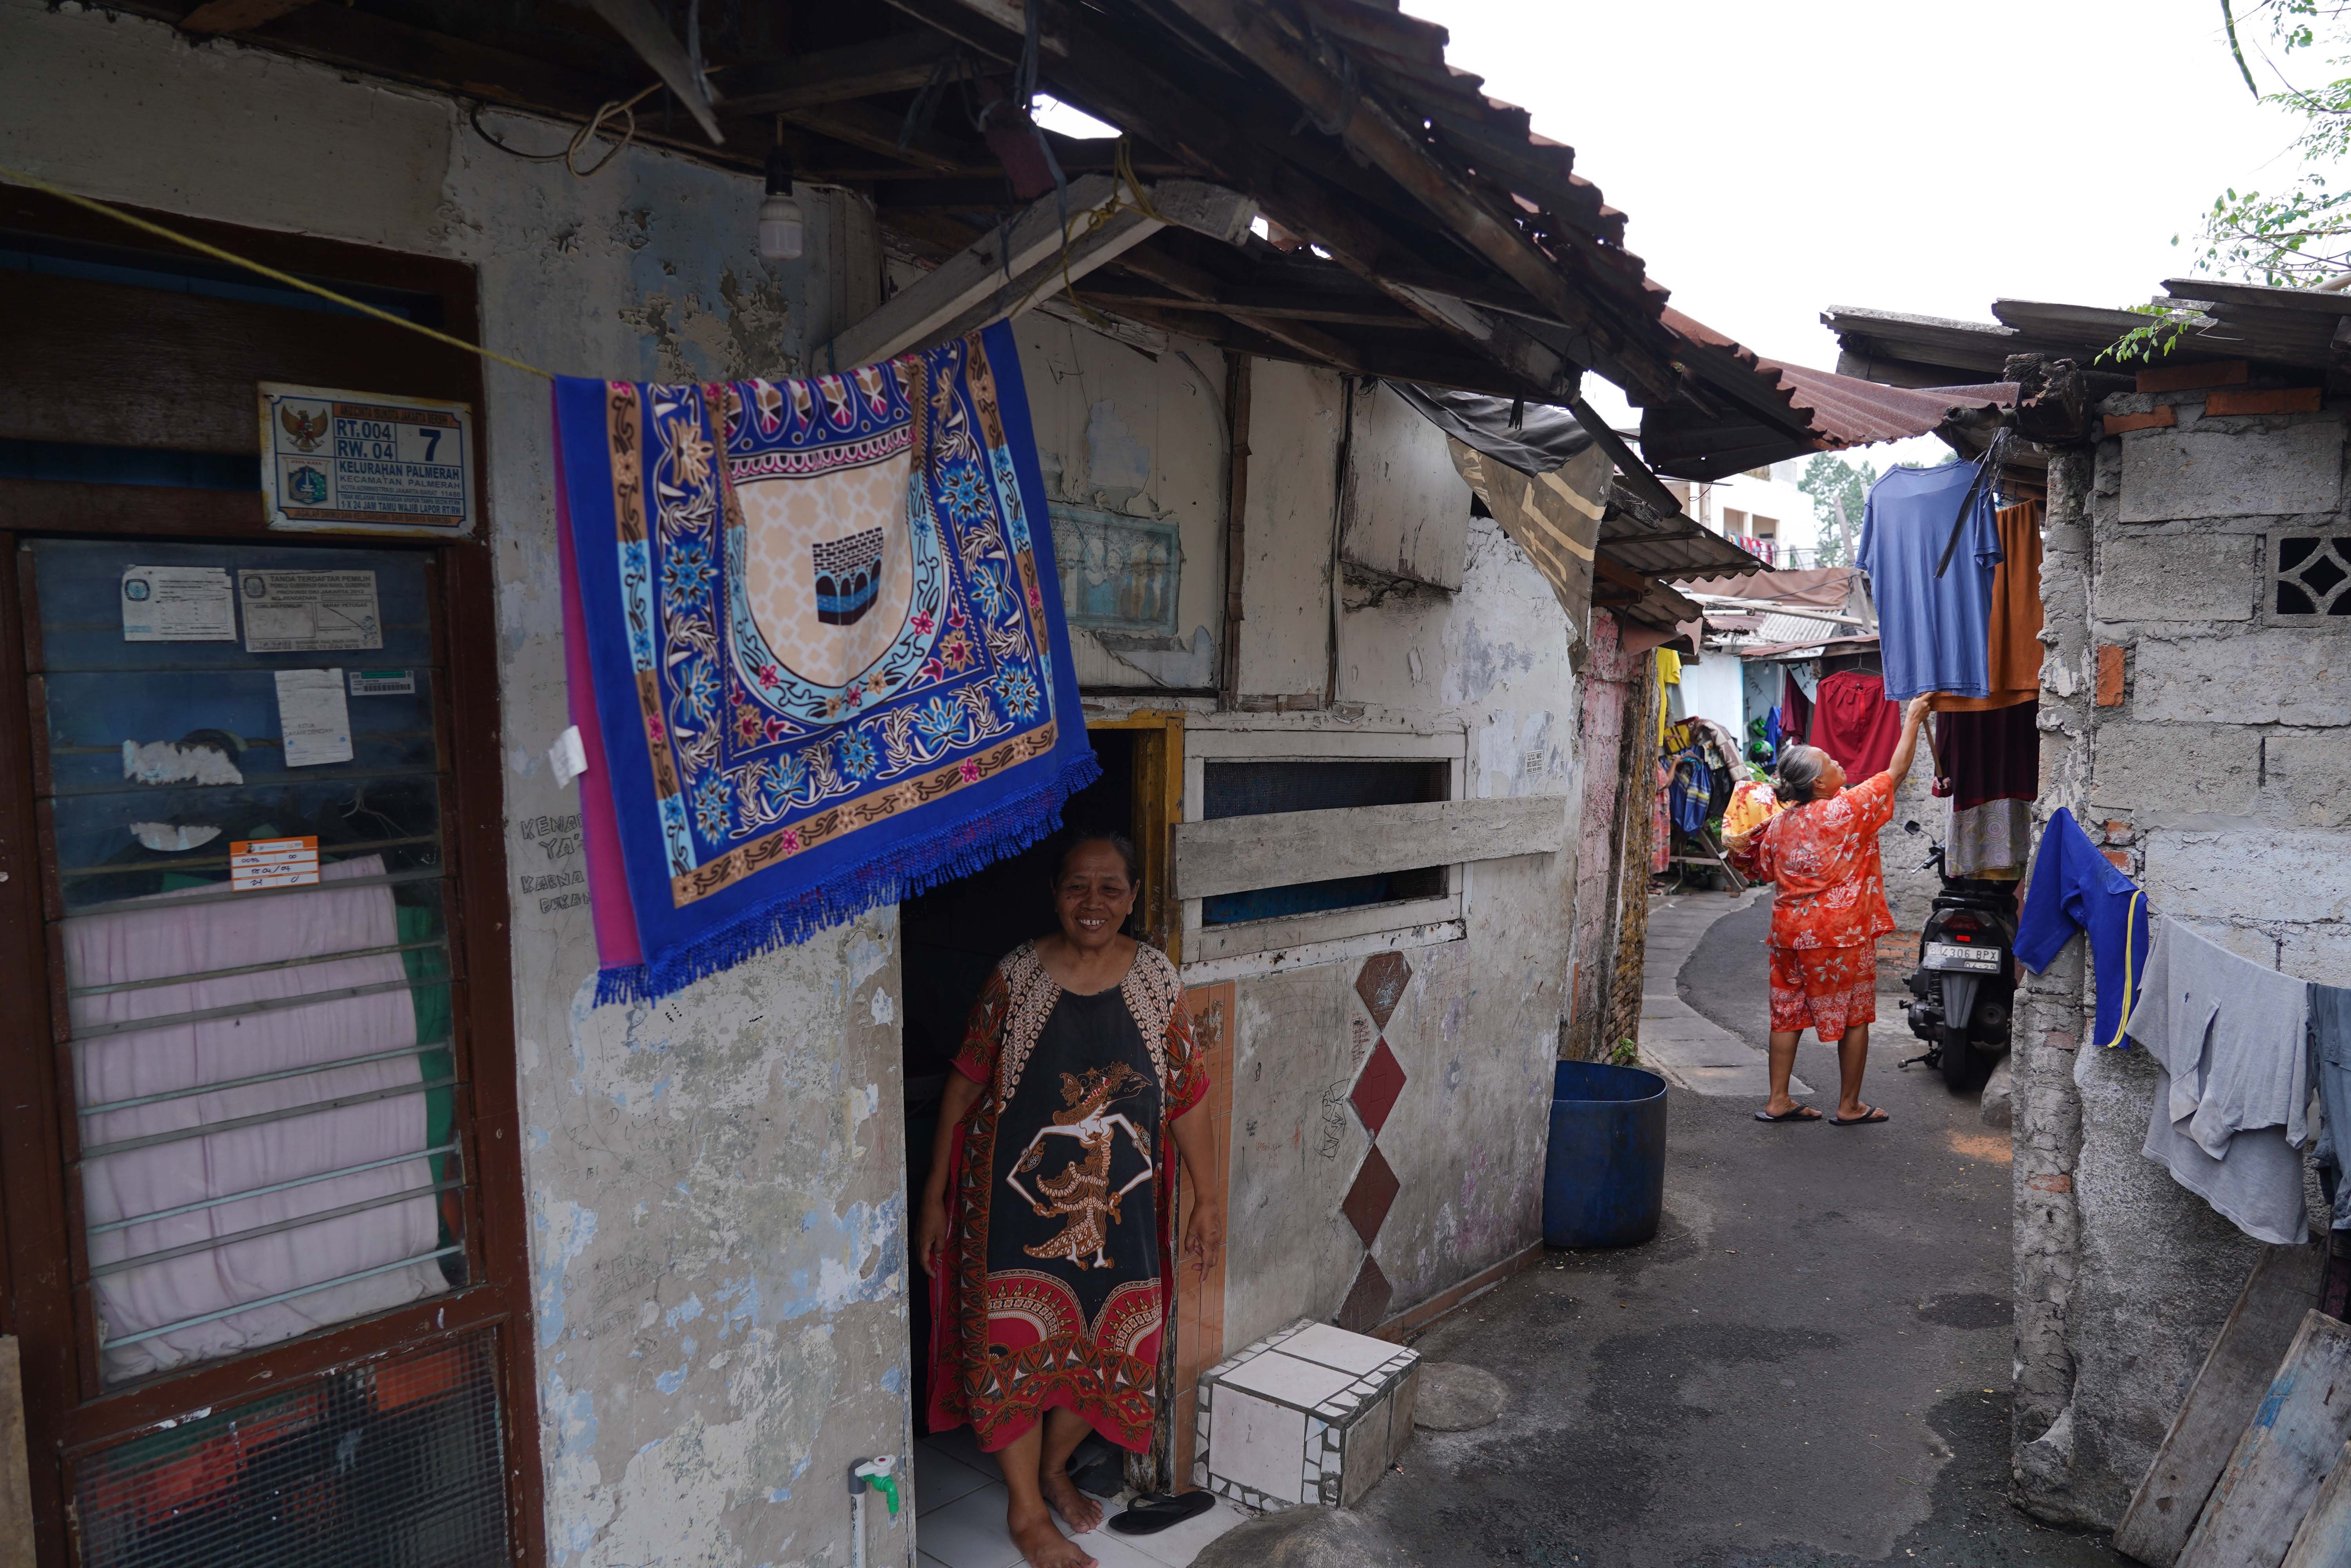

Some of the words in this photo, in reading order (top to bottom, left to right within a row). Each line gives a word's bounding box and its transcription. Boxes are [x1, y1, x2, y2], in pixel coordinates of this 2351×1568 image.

[401, 410, 426, 423] JAKARTA
[337, 439, 368, 458] RW.
[372, 443, 393, 460] 04
[419, 428, 441, 462] 7
[339, 460, 403, 476] KELURAHAN
[406, 465, 459, 480] PALMERAH
[339, 474, 402, 486] KECAMATAN
[408, 479, 460, 489] PALMERAH
[353, 501, 361, 510] 24
[363, 502, 377, 511] JAM
[378, 503, 396, 512] TAMU
[398, 504, 418, 513] WAJIB
[420, 505, 441, 514] LAPOR
[294, 510, 320, 518] JAGALAH
[427, 516, 452, 524] NARKOBA
[521, 871, 585, 894] KARNA
[1942, 948, 1970, 958] 4306
[1976, 950, 1997, 960] BPX
